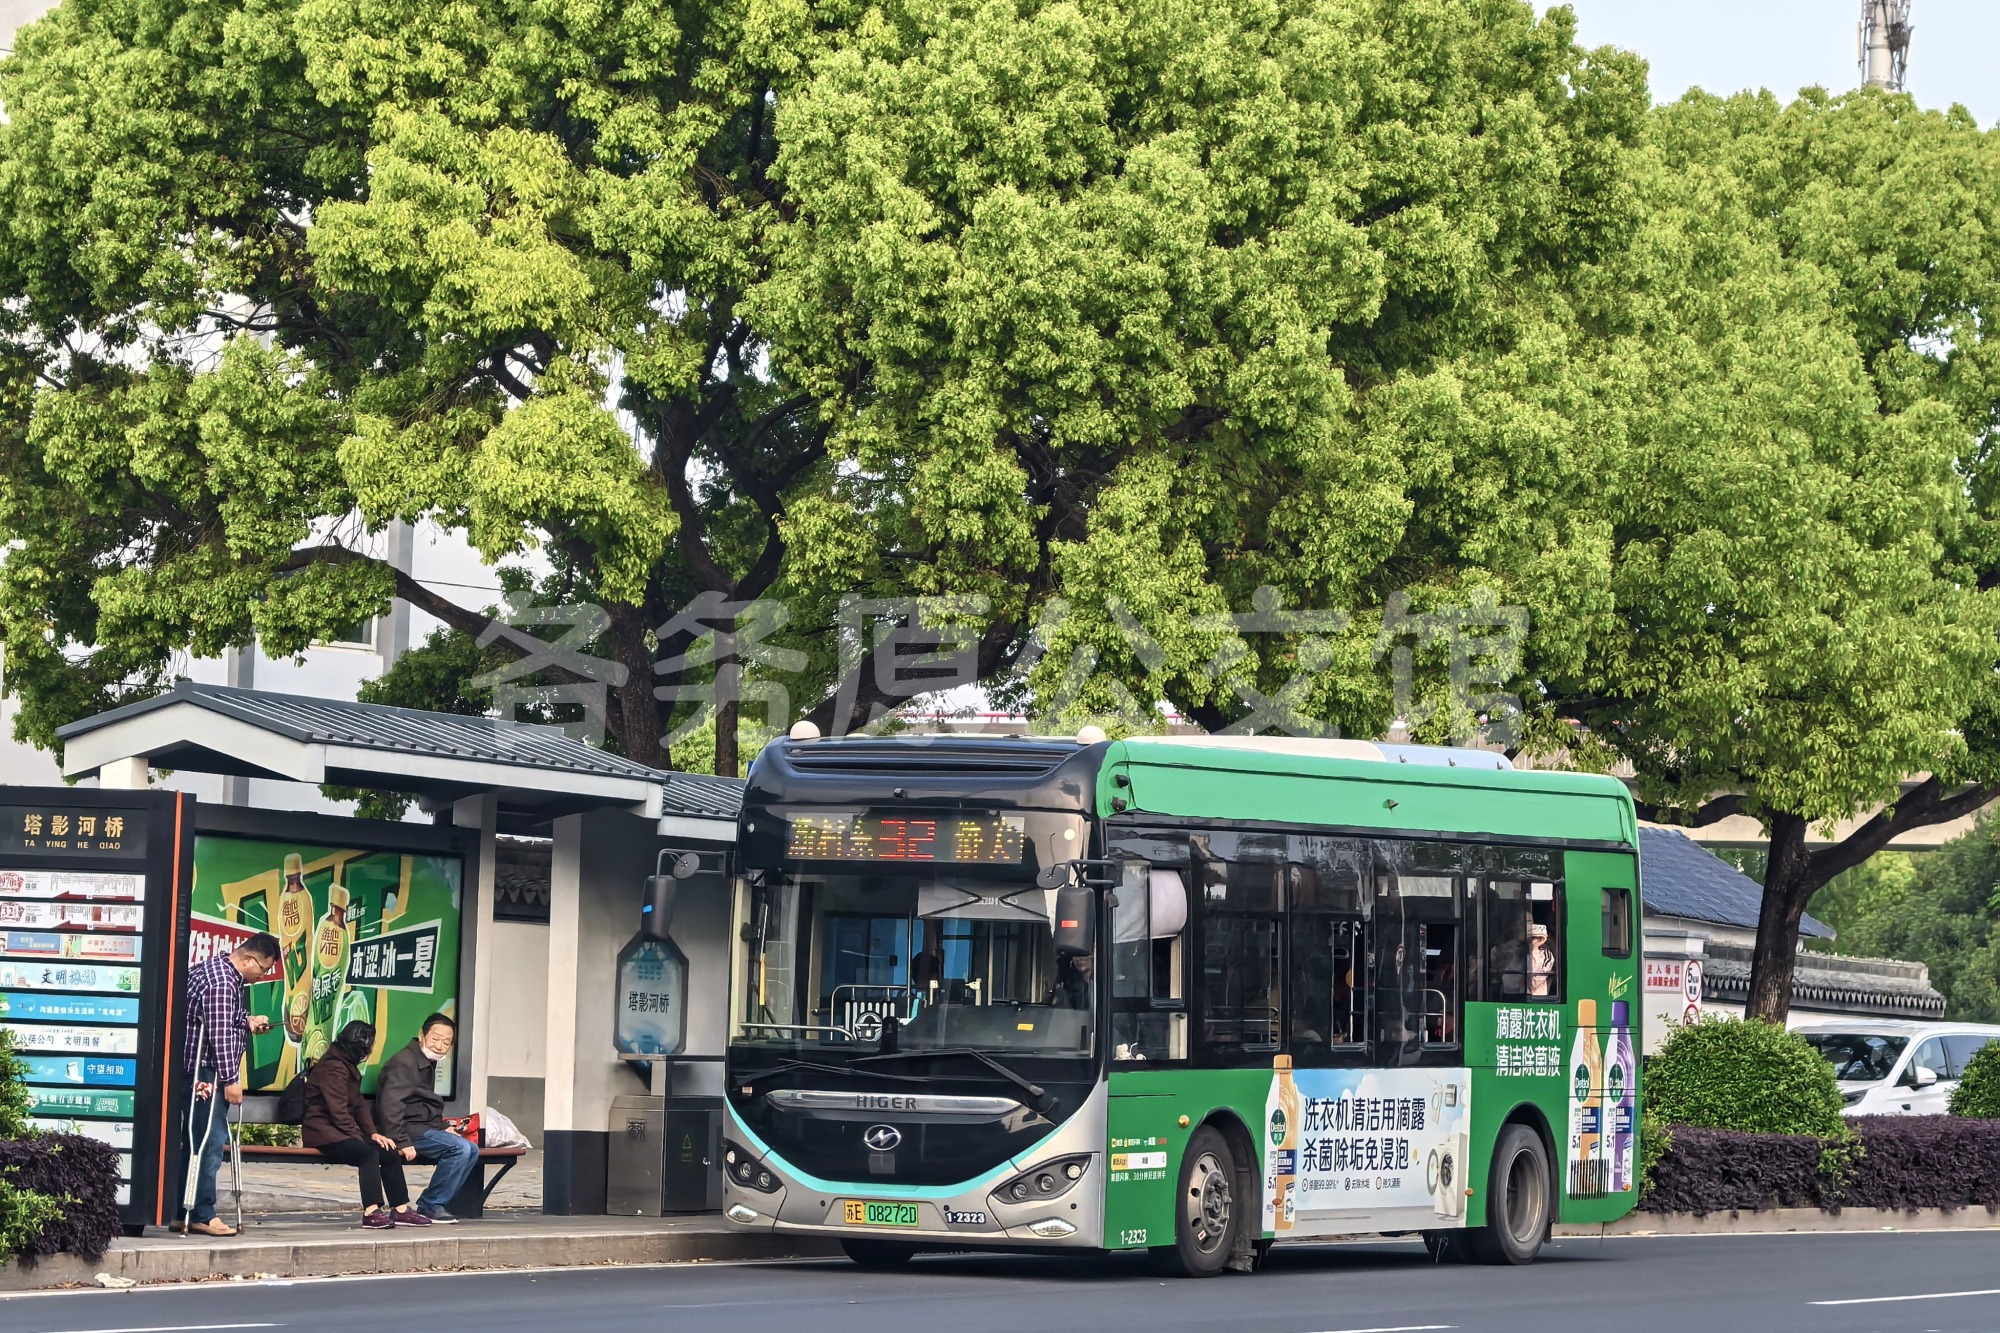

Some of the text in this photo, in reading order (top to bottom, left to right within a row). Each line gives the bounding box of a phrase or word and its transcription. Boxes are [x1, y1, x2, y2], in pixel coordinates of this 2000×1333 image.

[24, 813, 124, 838] 塔影河桥
[24, 839, 121, 850] TA YING HE QIAO
[879, 819, 936, 859] 32
[1, 906, 14, 917] 32
[628, 990, 670, 1014] 塔影河桥
[1496, 1007, 1561, 1040] 滴露洗衣机
[87, 1063, 124, 1076] 守望相助
[1495, 1045, 1561, 1077] 清洁除菌液
[856, 1095, 917, 1110] HIGER
[1303, 1097, 1426, 1132] 洗衣机清洁用滴露
[1302, 1137, 1409, 1173] 杀菌除垢免浸泡
[846, 1203, 862, 1221] 苏E
[1120, 1228, 1147, 1245] 1-2323
